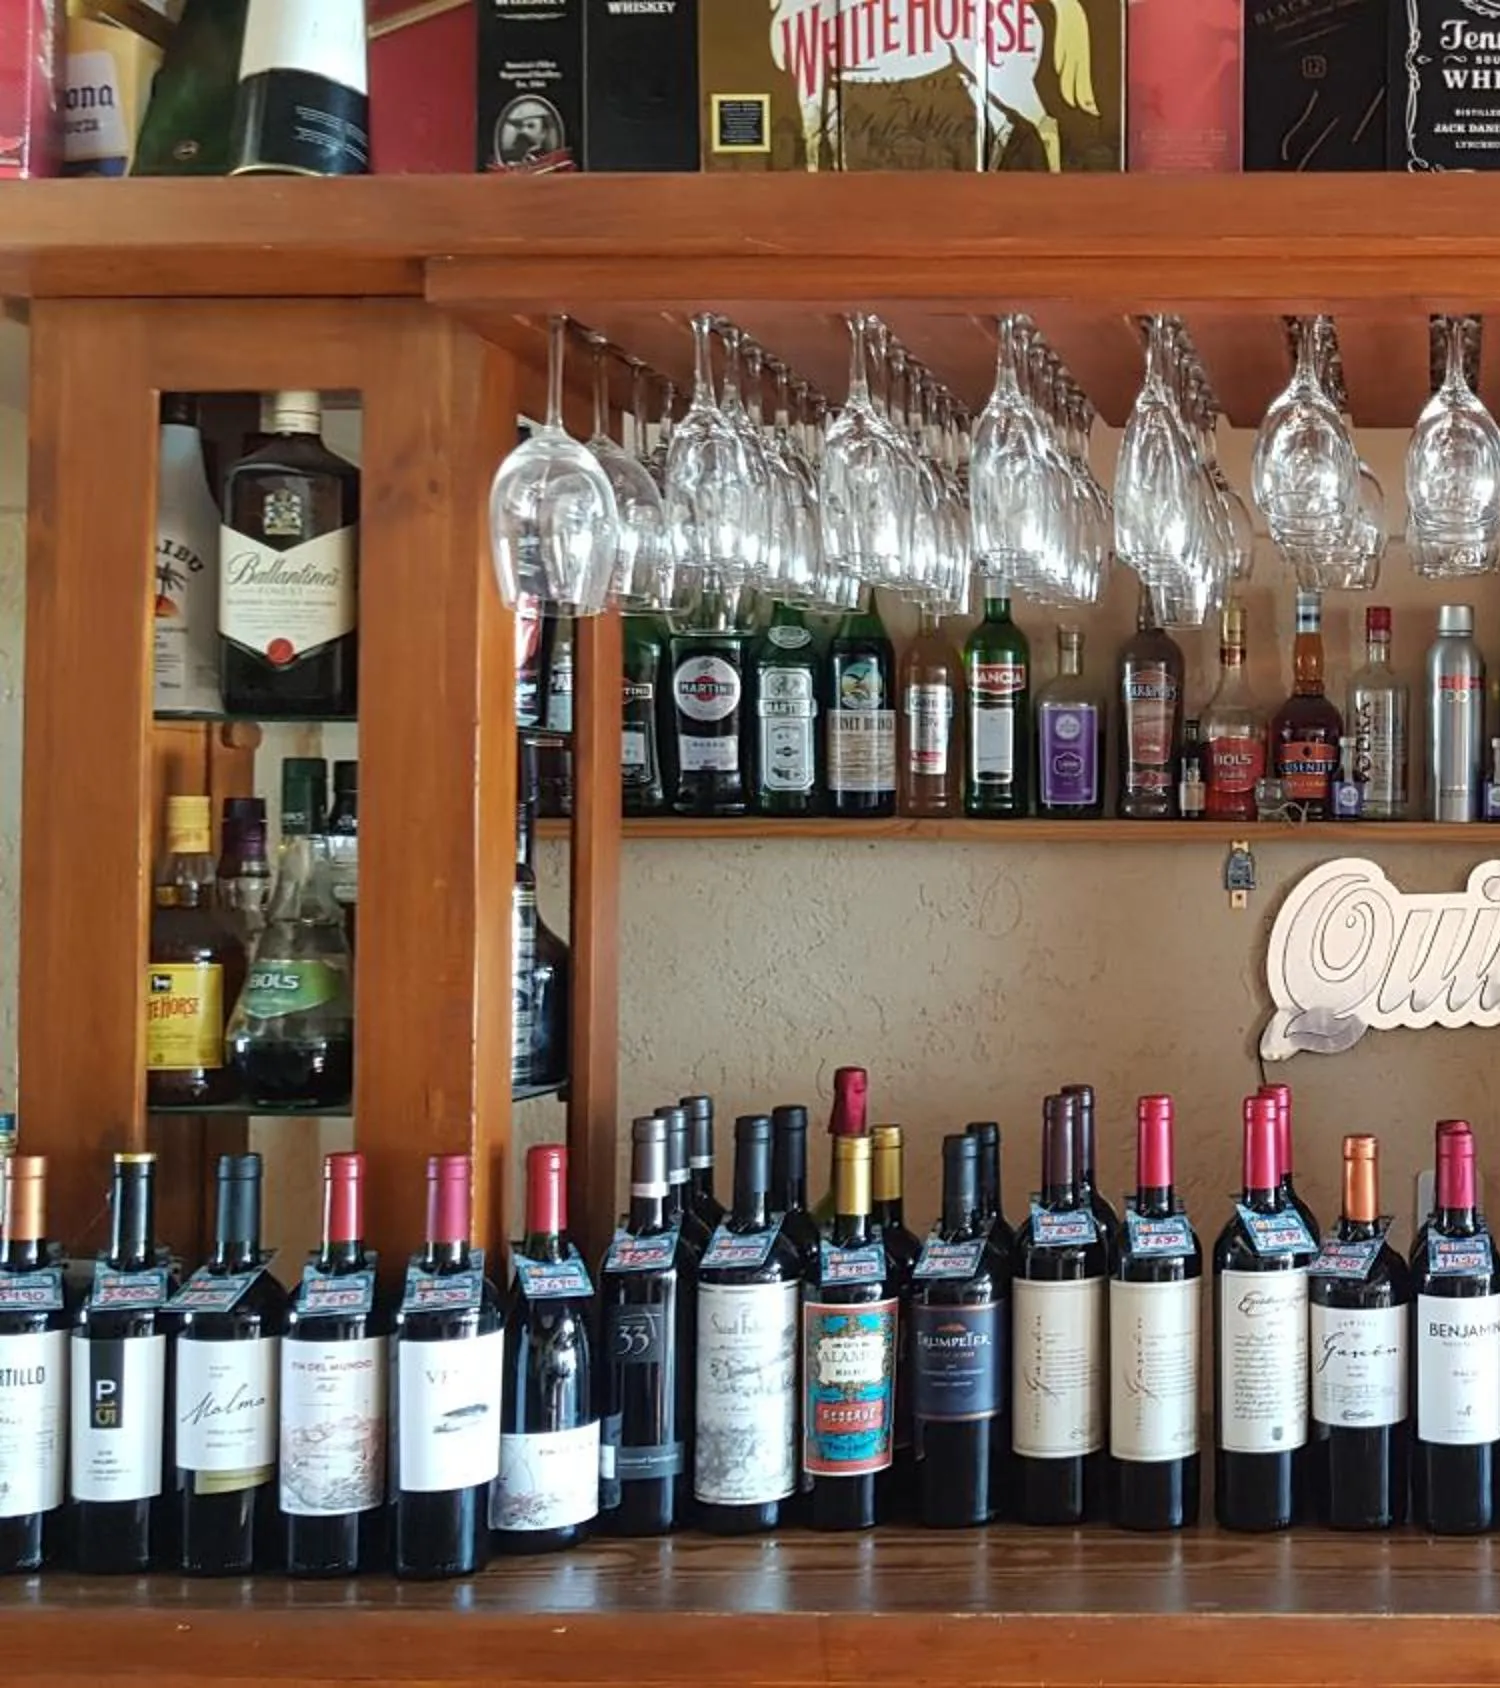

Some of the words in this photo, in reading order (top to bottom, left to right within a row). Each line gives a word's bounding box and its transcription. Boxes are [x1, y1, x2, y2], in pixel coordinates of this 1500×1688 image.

[608, 2, 677, 14] WHISKEY
[66, 84, 115, 110] ona
[973, 669, 1023, 684] ANCIA
[624, 685, 651, 695] TINI
[680, 681, 736, 696] MARTINI
[0, 1365, 46, 1388] RTILLO
